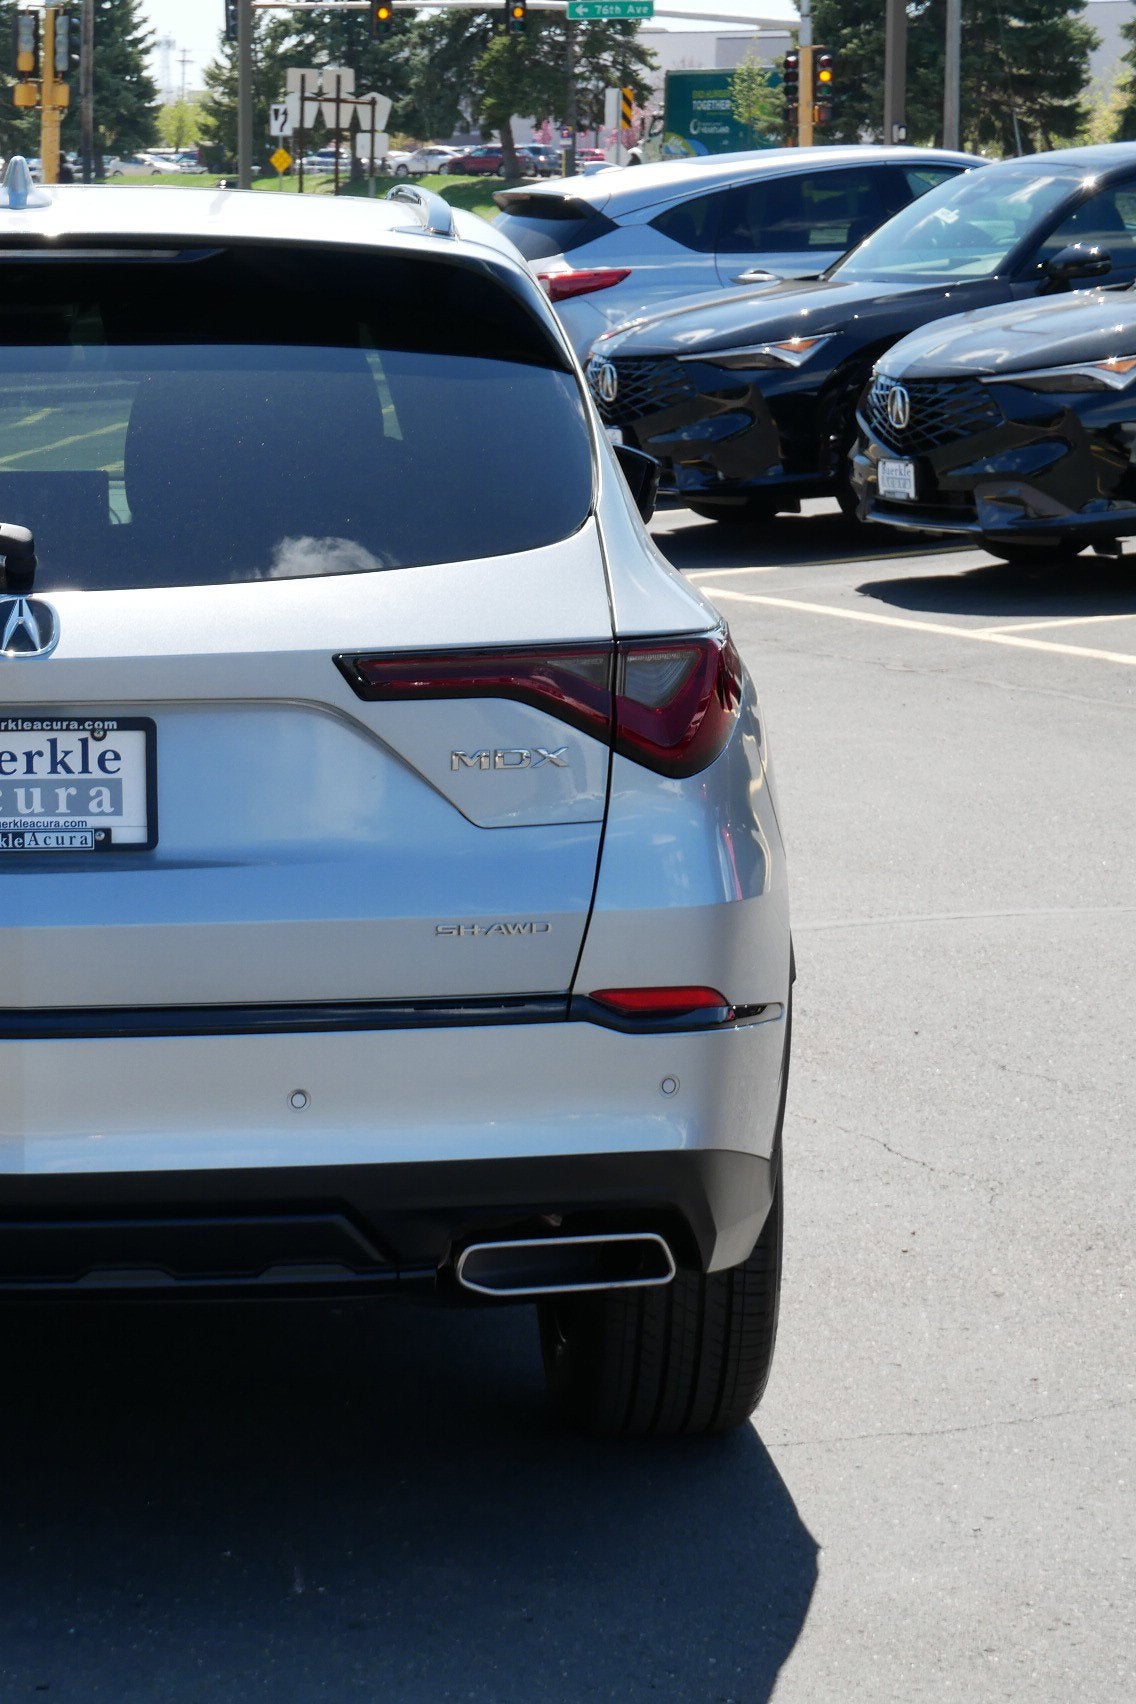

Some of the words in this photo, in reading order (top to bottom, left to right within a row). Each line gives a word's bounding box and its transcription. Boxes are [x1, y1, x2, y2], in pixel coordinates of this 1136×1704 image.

[594, 4, 622, 15] 76th
[626, 4, 649, 14] Ave
[450, 747, 569, 771] MDX
